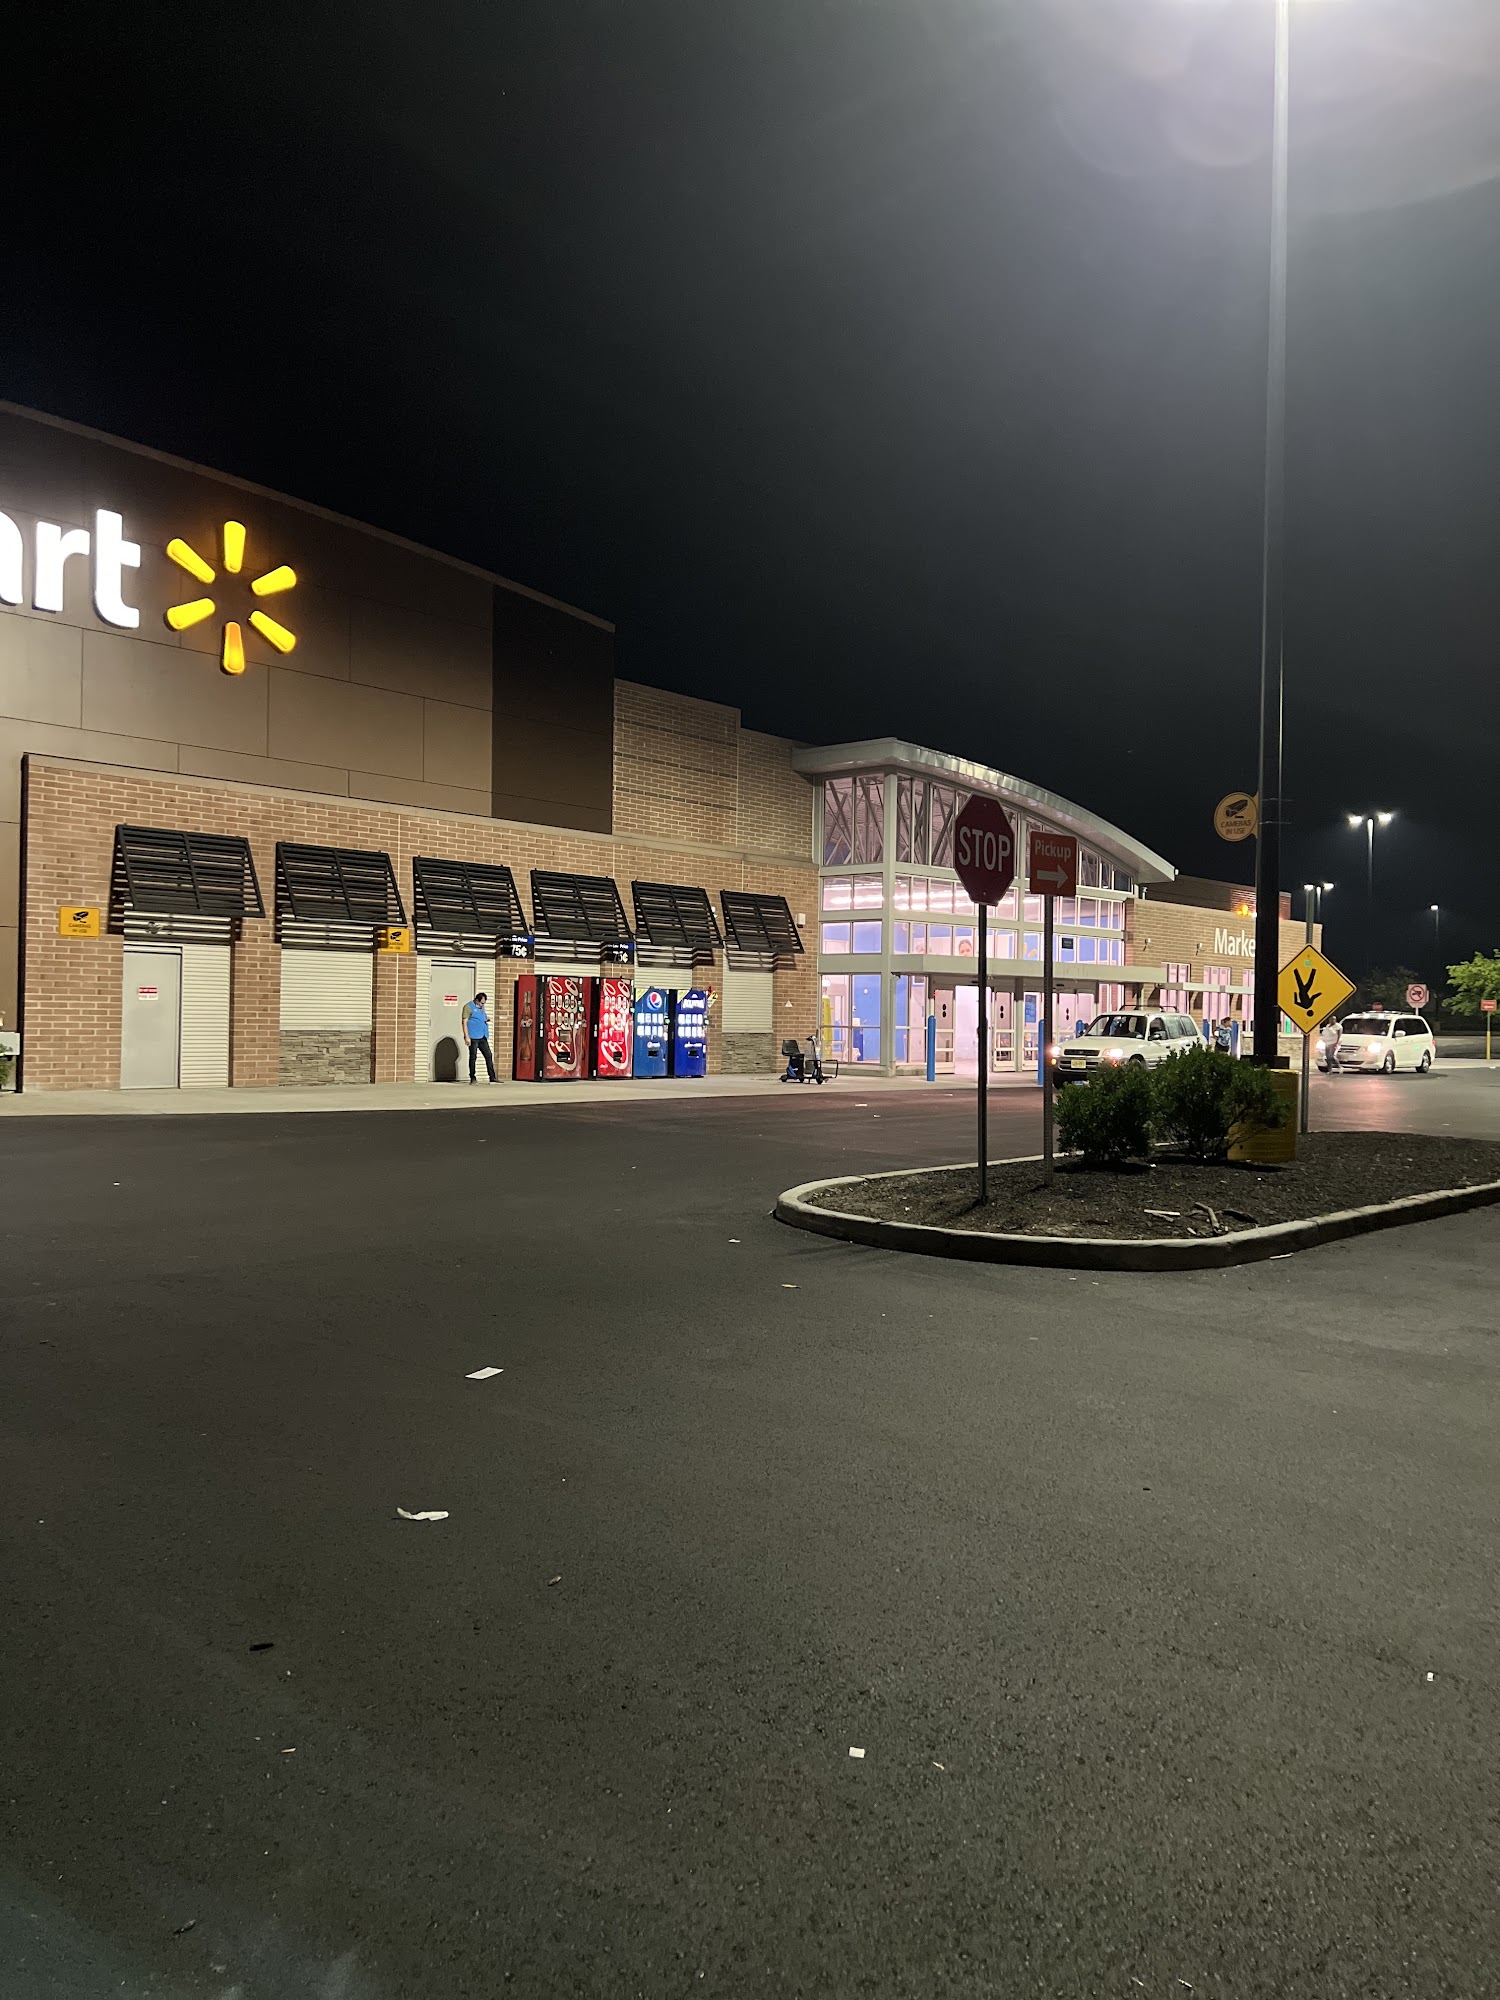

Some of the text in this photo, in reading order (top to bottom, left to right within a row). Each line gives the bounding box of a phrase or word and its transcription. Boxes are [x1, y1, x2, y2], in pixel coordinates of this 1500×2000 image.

[1221, 820, 1252, 828] CAMERAS
[958, 826, 1011, 872] STOP
[1034, 839, 1072, 863] Pickup
[511, 944, 527, 957] 75¢
[1214, 927, 1256, 958] Marke
